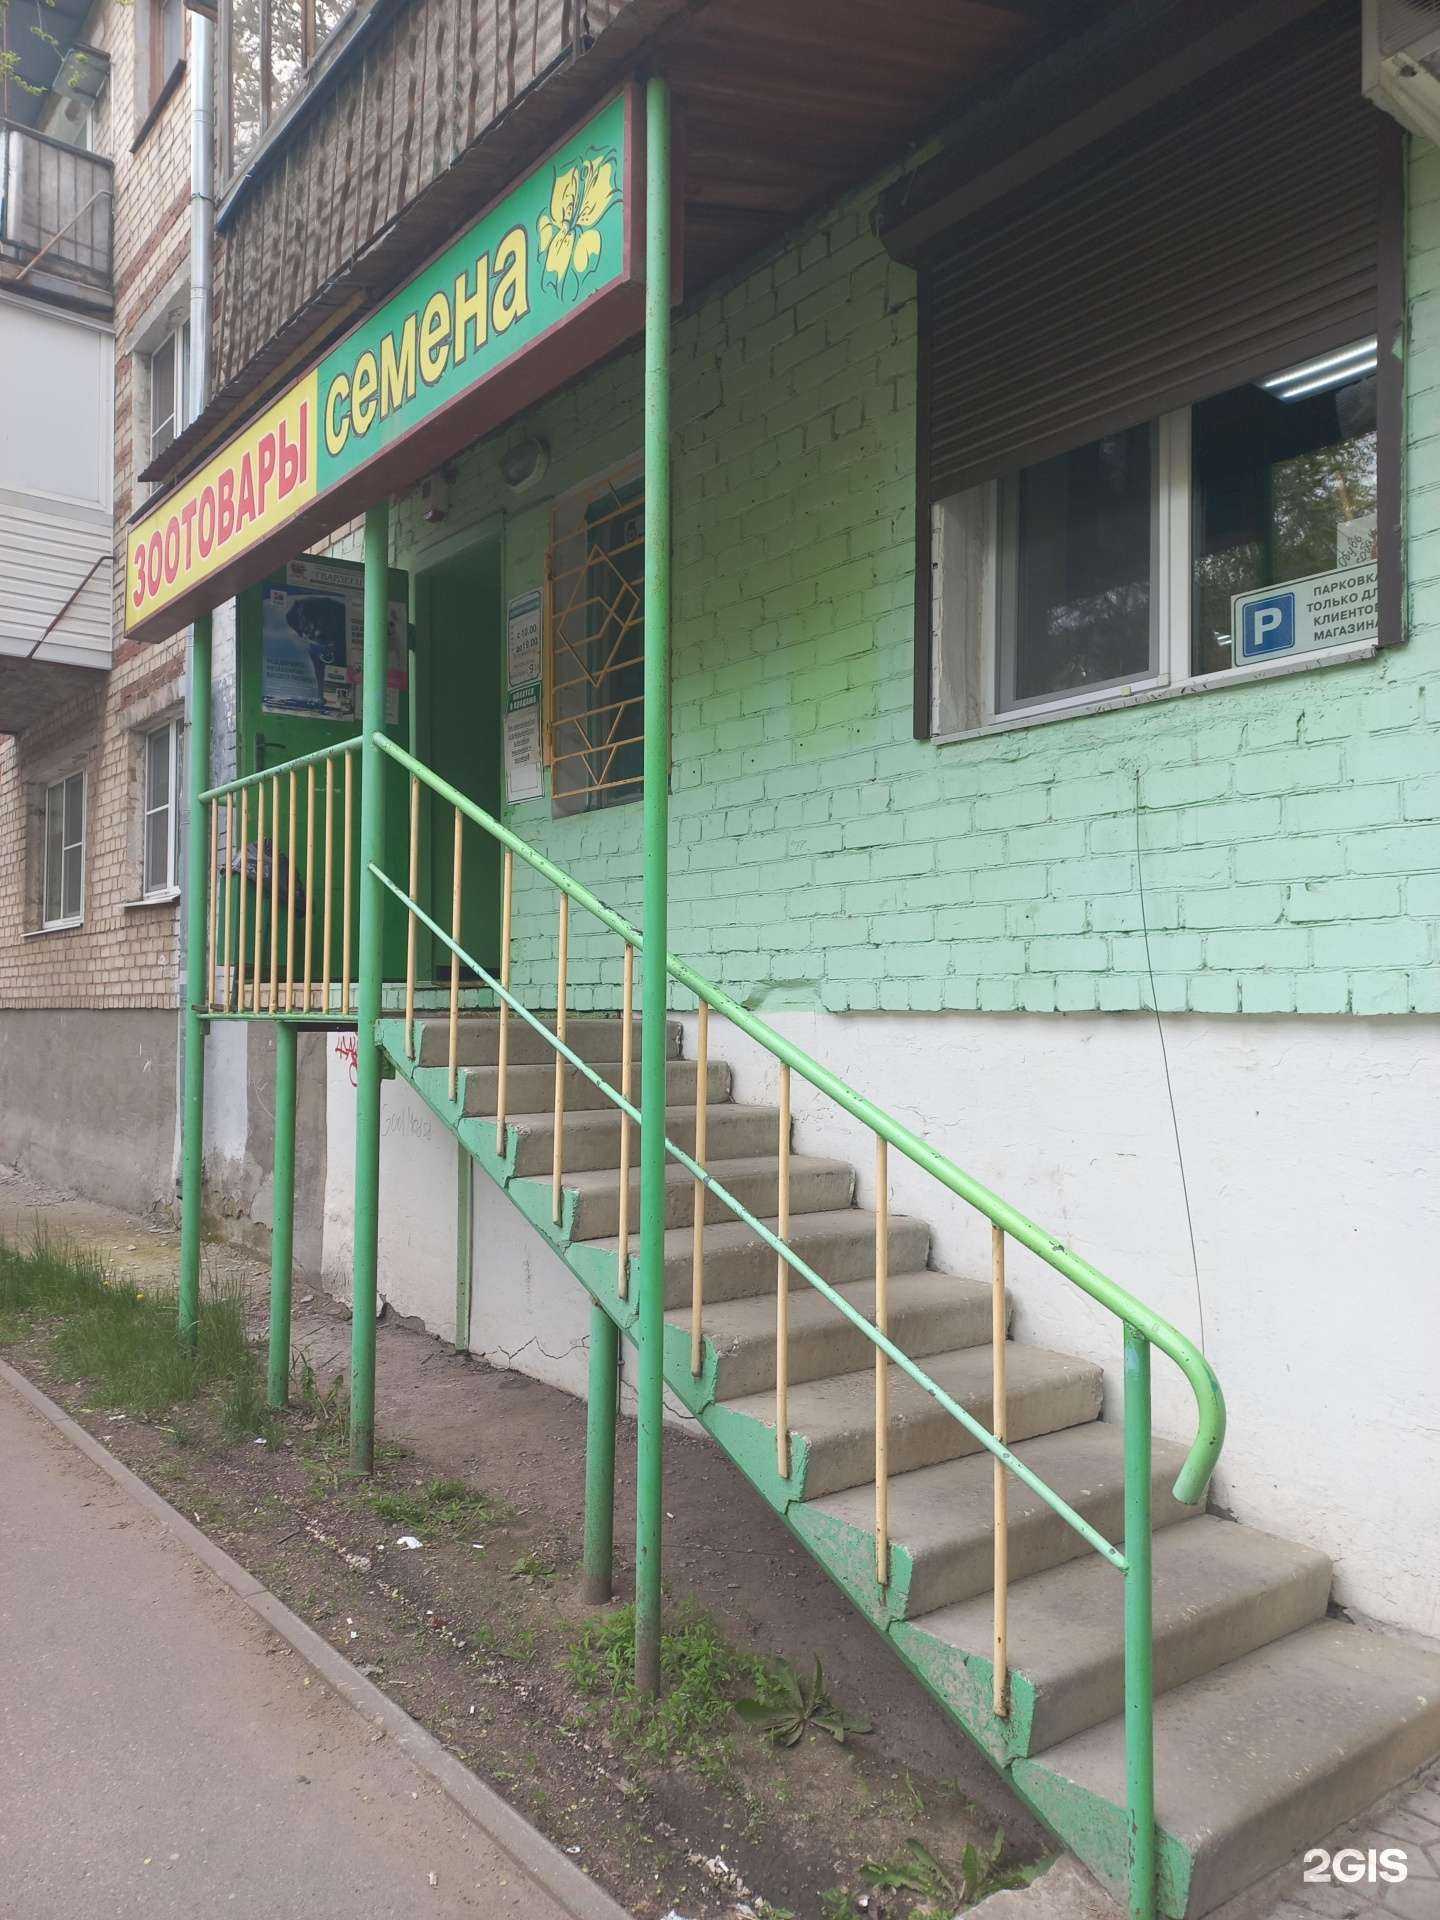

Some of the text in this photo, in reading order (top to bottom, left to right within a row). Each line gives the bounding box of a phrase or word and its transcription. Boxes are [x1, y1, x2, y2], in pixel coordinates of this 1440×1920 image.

[325, 224, 531, 457] семена
[133, 400, 308, 608] ЗООТОВАРЫ
[1254, 607, 1283, 646] P
[1306, 588, 1378, 613] ТОЛЬКО ДЛ
